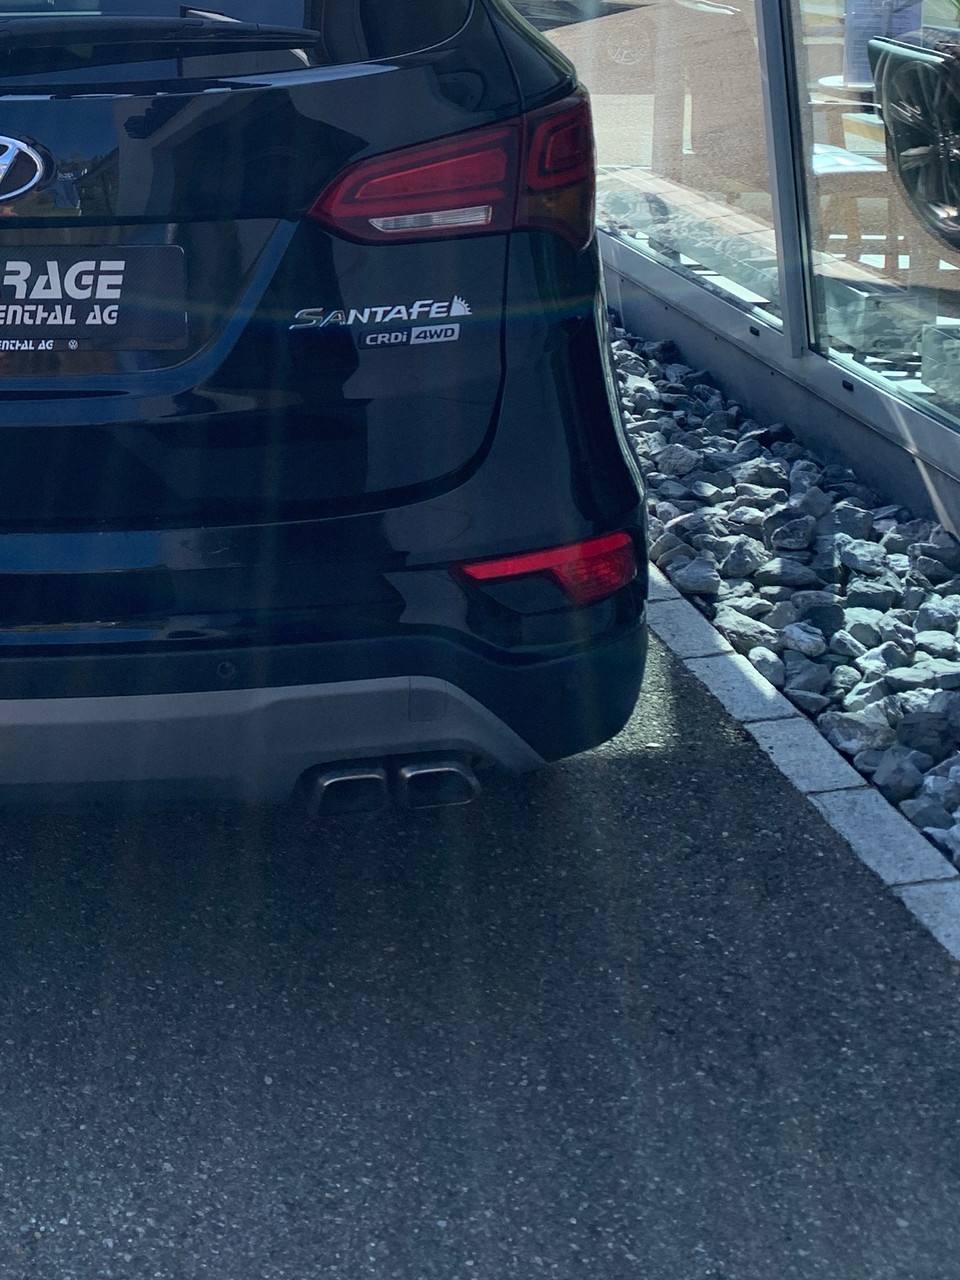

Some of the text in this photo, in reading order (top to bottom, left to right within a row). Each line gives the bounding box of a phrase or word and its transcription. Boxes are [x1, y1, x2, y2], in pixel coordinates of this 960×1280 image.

[85, 304, 120, 325] AG
[37, 339, 54, 350] AG
[365, 326, 456, 345] CRDi 4WD
